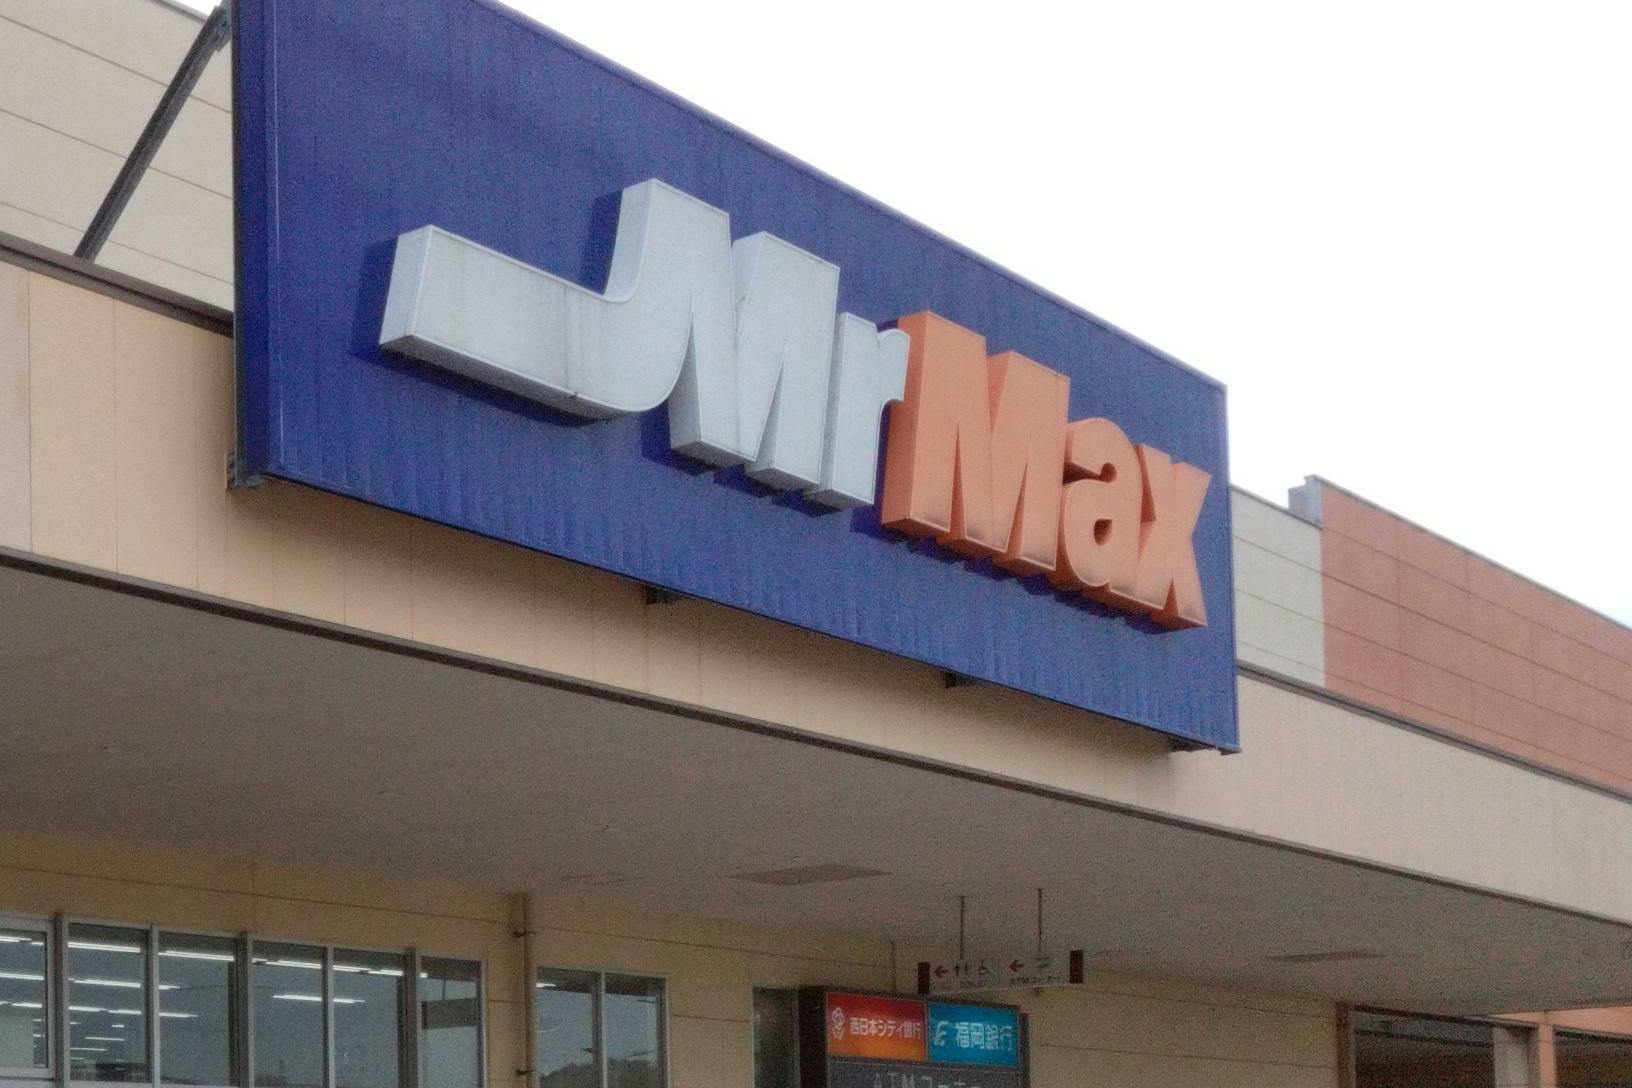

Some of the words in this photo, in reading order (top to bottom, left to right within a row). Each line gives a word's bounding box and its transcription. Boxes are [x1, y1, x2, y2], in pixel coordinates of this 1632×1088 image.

[378, 178, 1211, 629] MrMax
[849, 1016, 921, 1040] 西日本シティ銀行
[955, 1021, 1013, 1051] 福岡銀行
